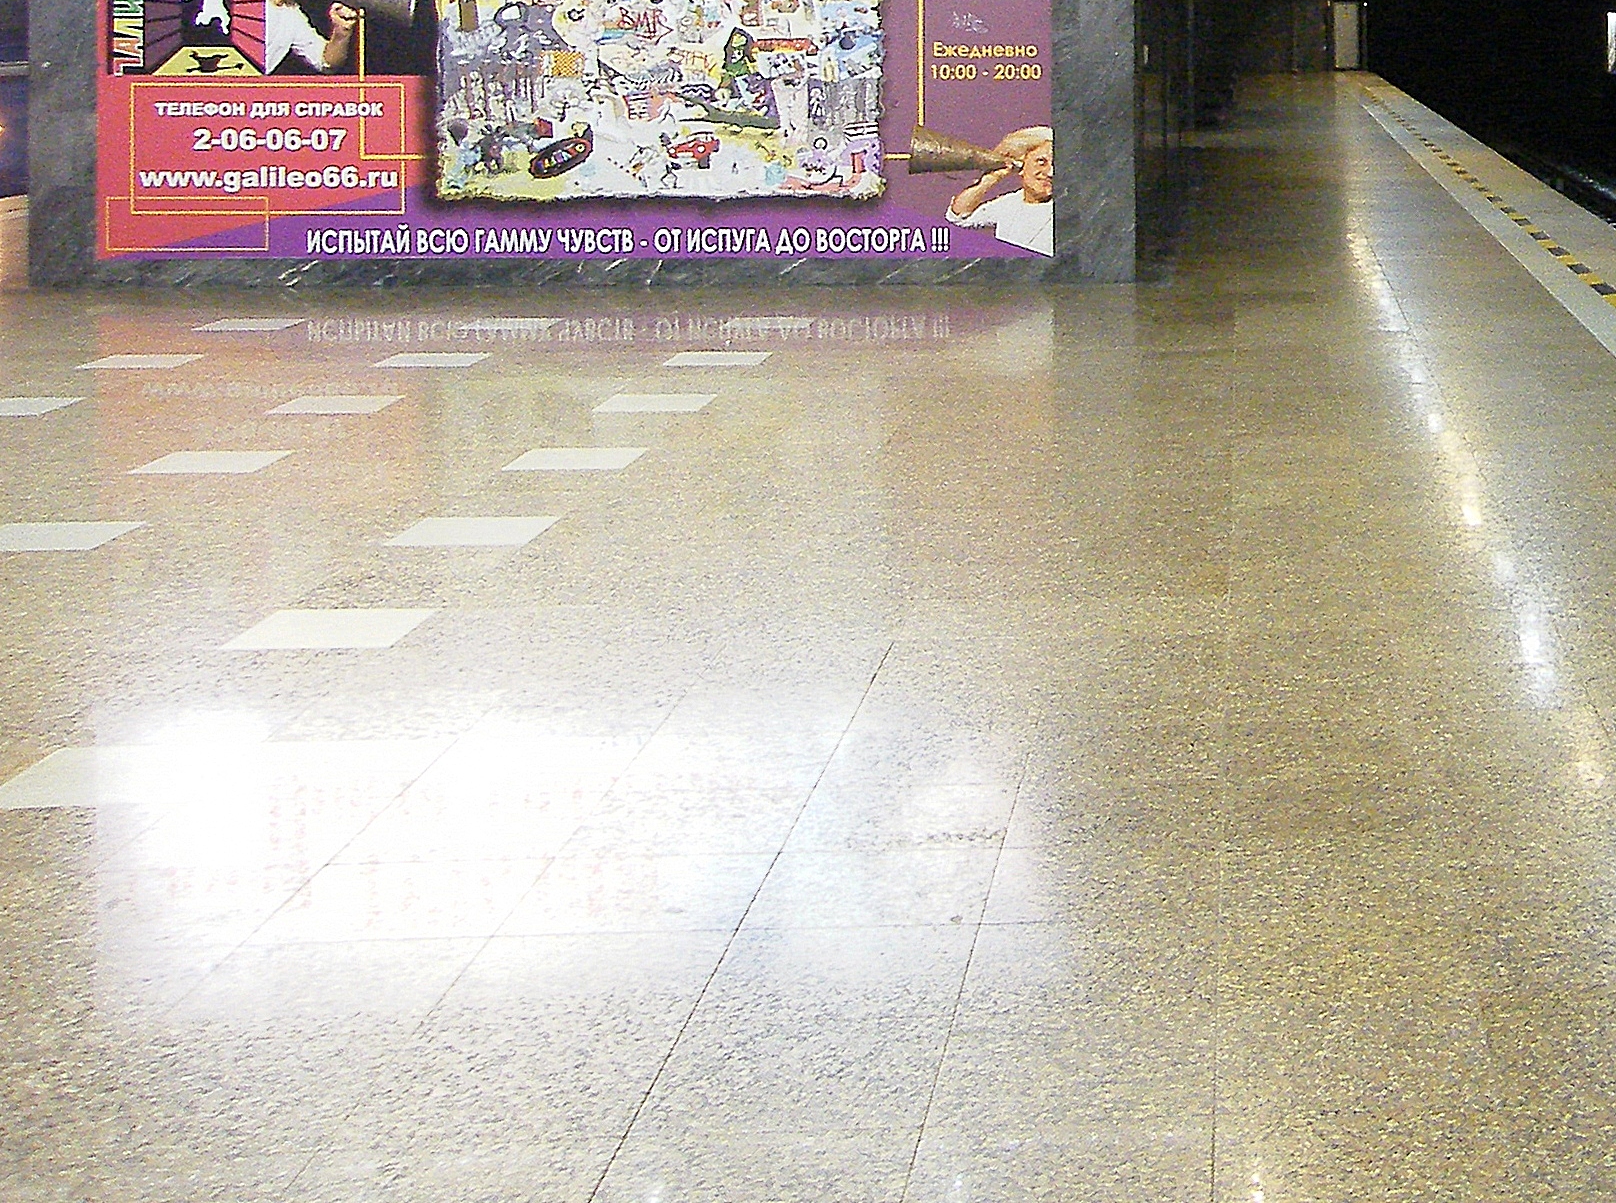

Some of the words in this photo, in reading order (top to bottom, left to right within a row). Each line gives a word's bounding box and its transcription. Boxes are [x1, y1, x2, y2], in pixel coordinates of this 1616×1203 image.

[932, 41, 1038, 59] Ежедневно
[930, 64, 977, 80] 10:00
[993, 64, 1042, 80] 20:00
[154, 102, 246, 118] ТЕЛЕФОН
[250, 102, 290, 119] ДЛЯ
[294, 102, 384, 119] СПРАВОК
[192, 128, 348, 152] 2-06-06-07
[138, 165, 399, 193] www.galileo66.ru
[305, 224, 411, 254] ИСПЫТАЙ
[416, 228, 469, 254] ВСЮ
[474, 228, 551, 254] ГАММУ
[556, 228, 634, 253] ЧУВСТВ
[653, 227, 681, 254] ОТ
[686, 227, 772, 253] ИСПУГА
[774, 227, 812, 255] ДО
[815, 227, 927, 254] ВОСТОРГА
[930, 227, 951, 253] !!!
